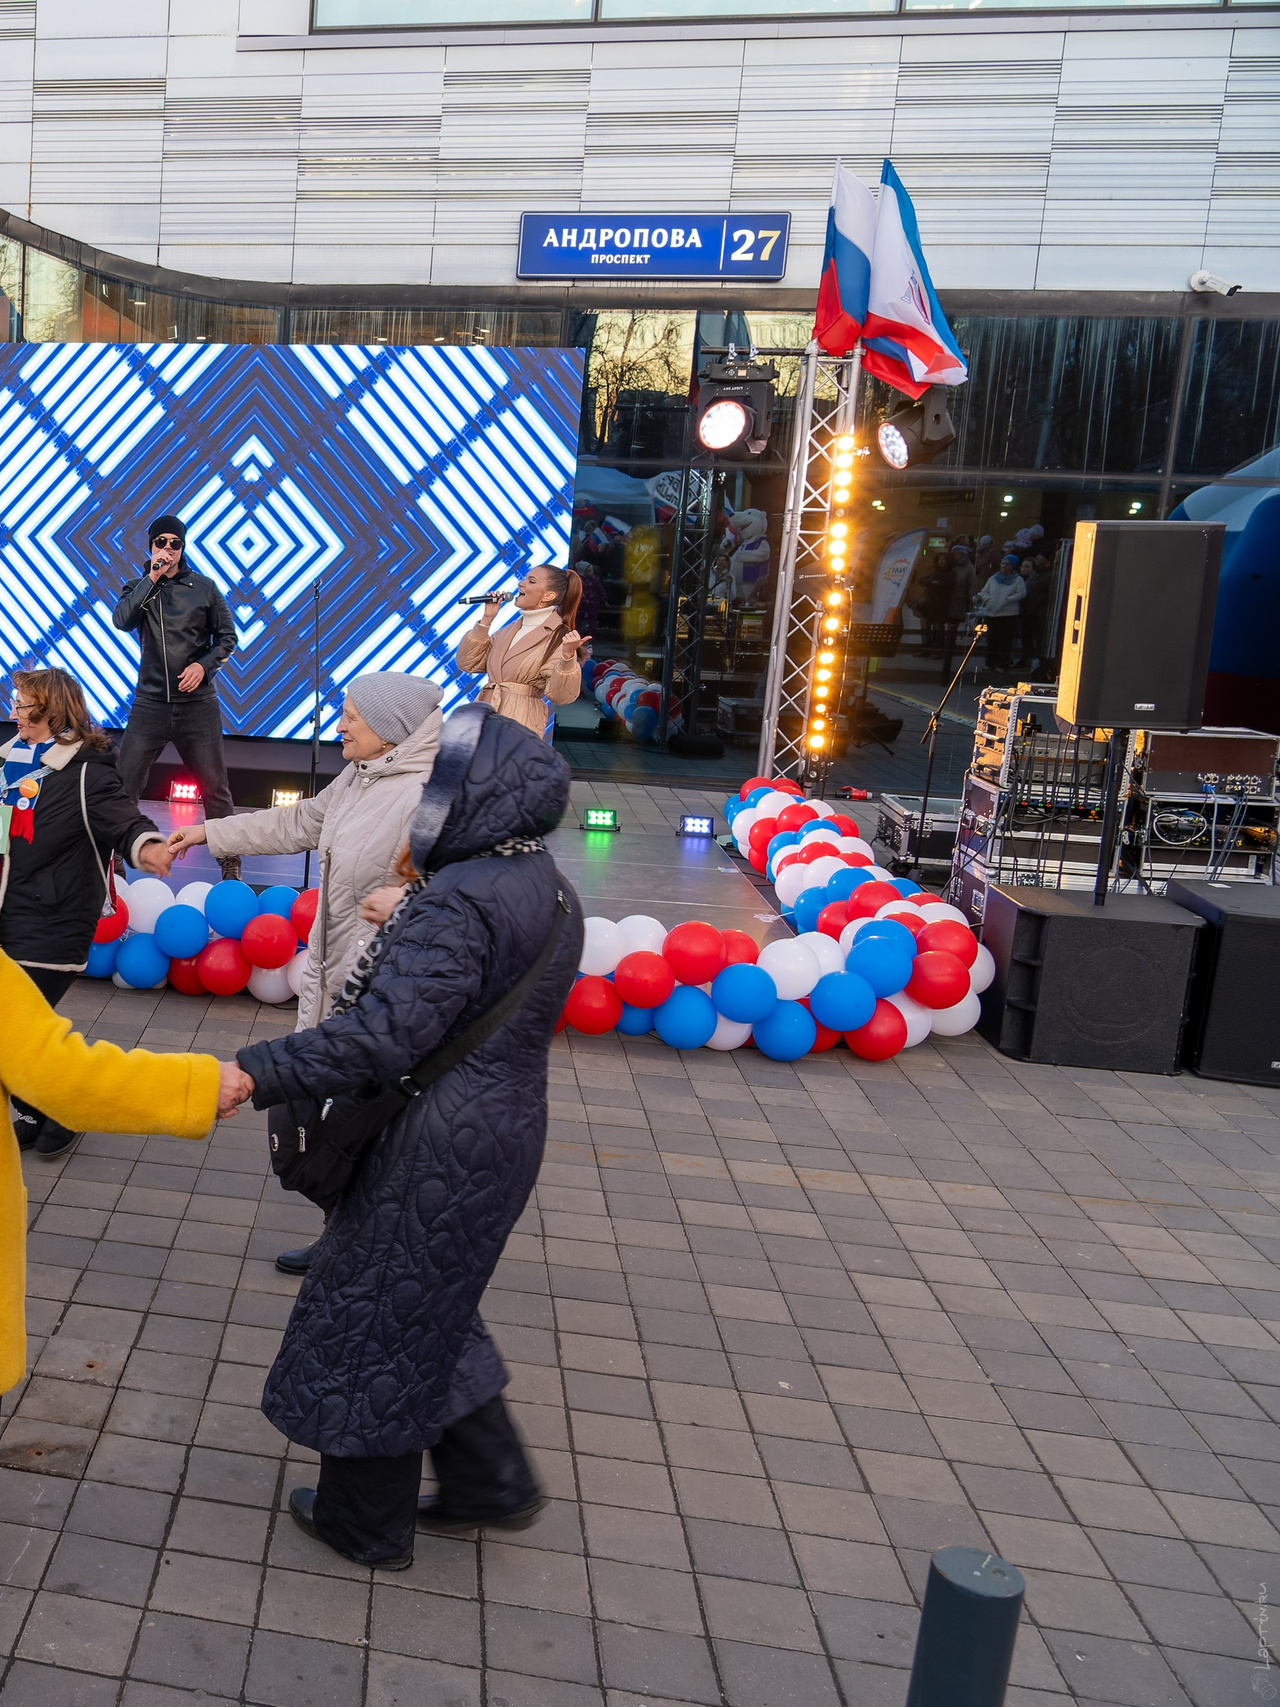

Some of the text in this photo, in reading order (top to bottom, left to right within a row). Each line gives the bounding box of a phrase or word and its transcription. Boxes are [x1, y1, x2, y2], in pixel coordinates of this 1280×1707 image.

[542, 228, 782, 261] АНДРОПОВА 27
[590, 253, 651, 265] ПРОСПЕКТ
